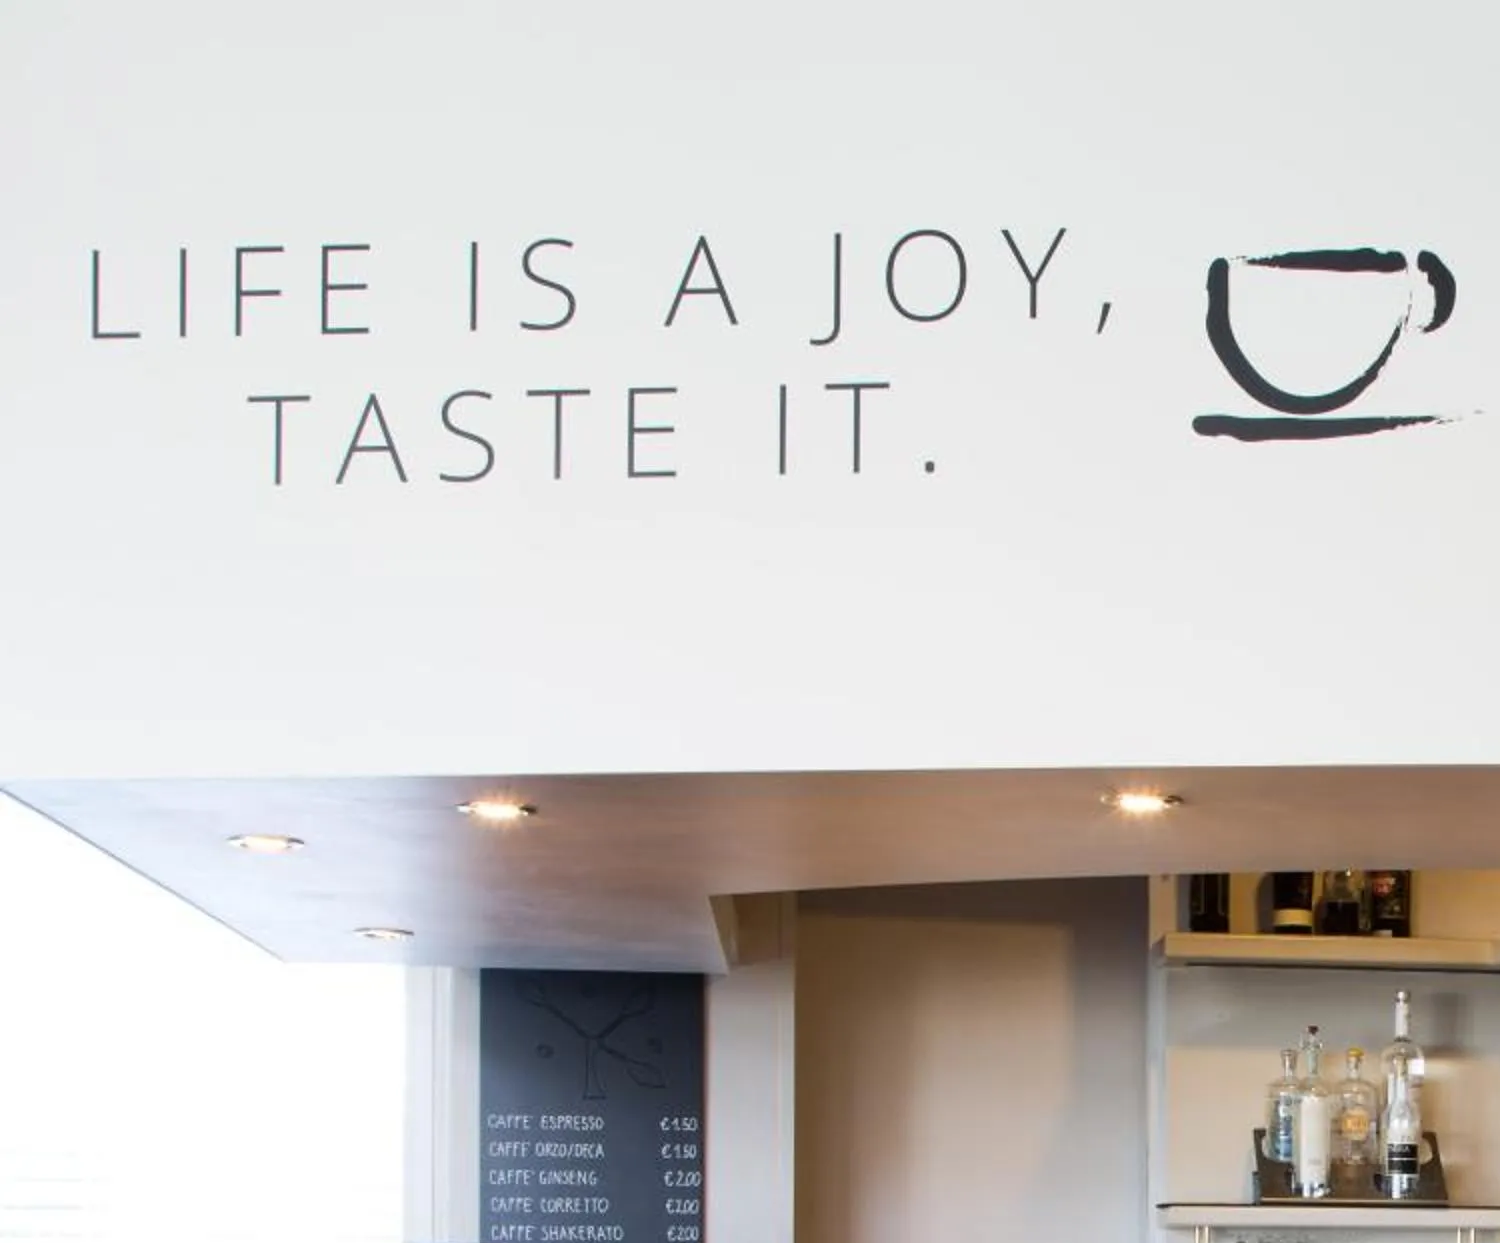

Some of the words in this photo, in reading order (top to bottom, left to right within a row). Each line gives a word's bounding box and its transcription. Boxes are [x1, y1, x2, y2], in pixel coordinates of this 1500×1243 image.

[90, 242, 372, 341] LIFE
[468, 236, 578, 333] IS
[663, 234, 740, 328] A
[808, 226, 1113, 348] JOY,
[245, 385, 679, 487] TASTE
[777, 380, 936, 477] IT.
[539, 1114, 605, 1131] ESPRESSO
[539, 1169, 598, 1186] GINSENG
[540, 1196, 610, 1214] CORRETTO
[540, 1224, 625, 1241] SHAKERATO
